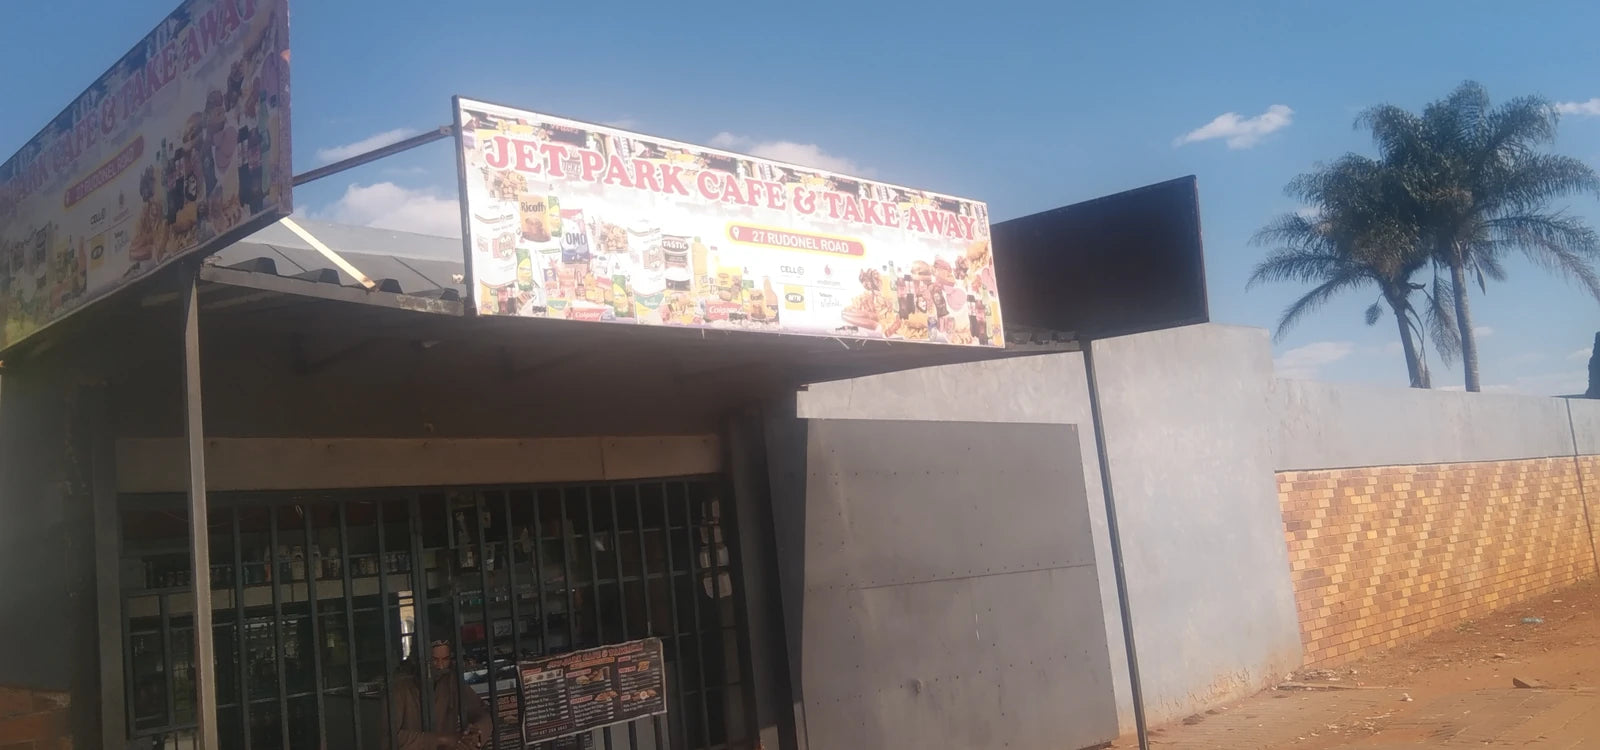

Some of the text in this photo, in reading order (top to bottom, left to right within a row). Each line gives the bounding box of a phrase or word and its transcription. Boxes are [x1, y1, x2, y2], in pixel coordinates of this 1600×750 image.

[53, 112, 98, 172] CAFE
[100, 101, 117, 134] &
[120, 47, 177, 121] TAKE
[485, 136, 977, 241] JET PARK CAFE & TAKE AWAY
[566, 232, 587, 246] OMO
[662, 240, 687, 250] TASTIC
[752, 231, 849, 254] 27 RUDONEL ROAD
